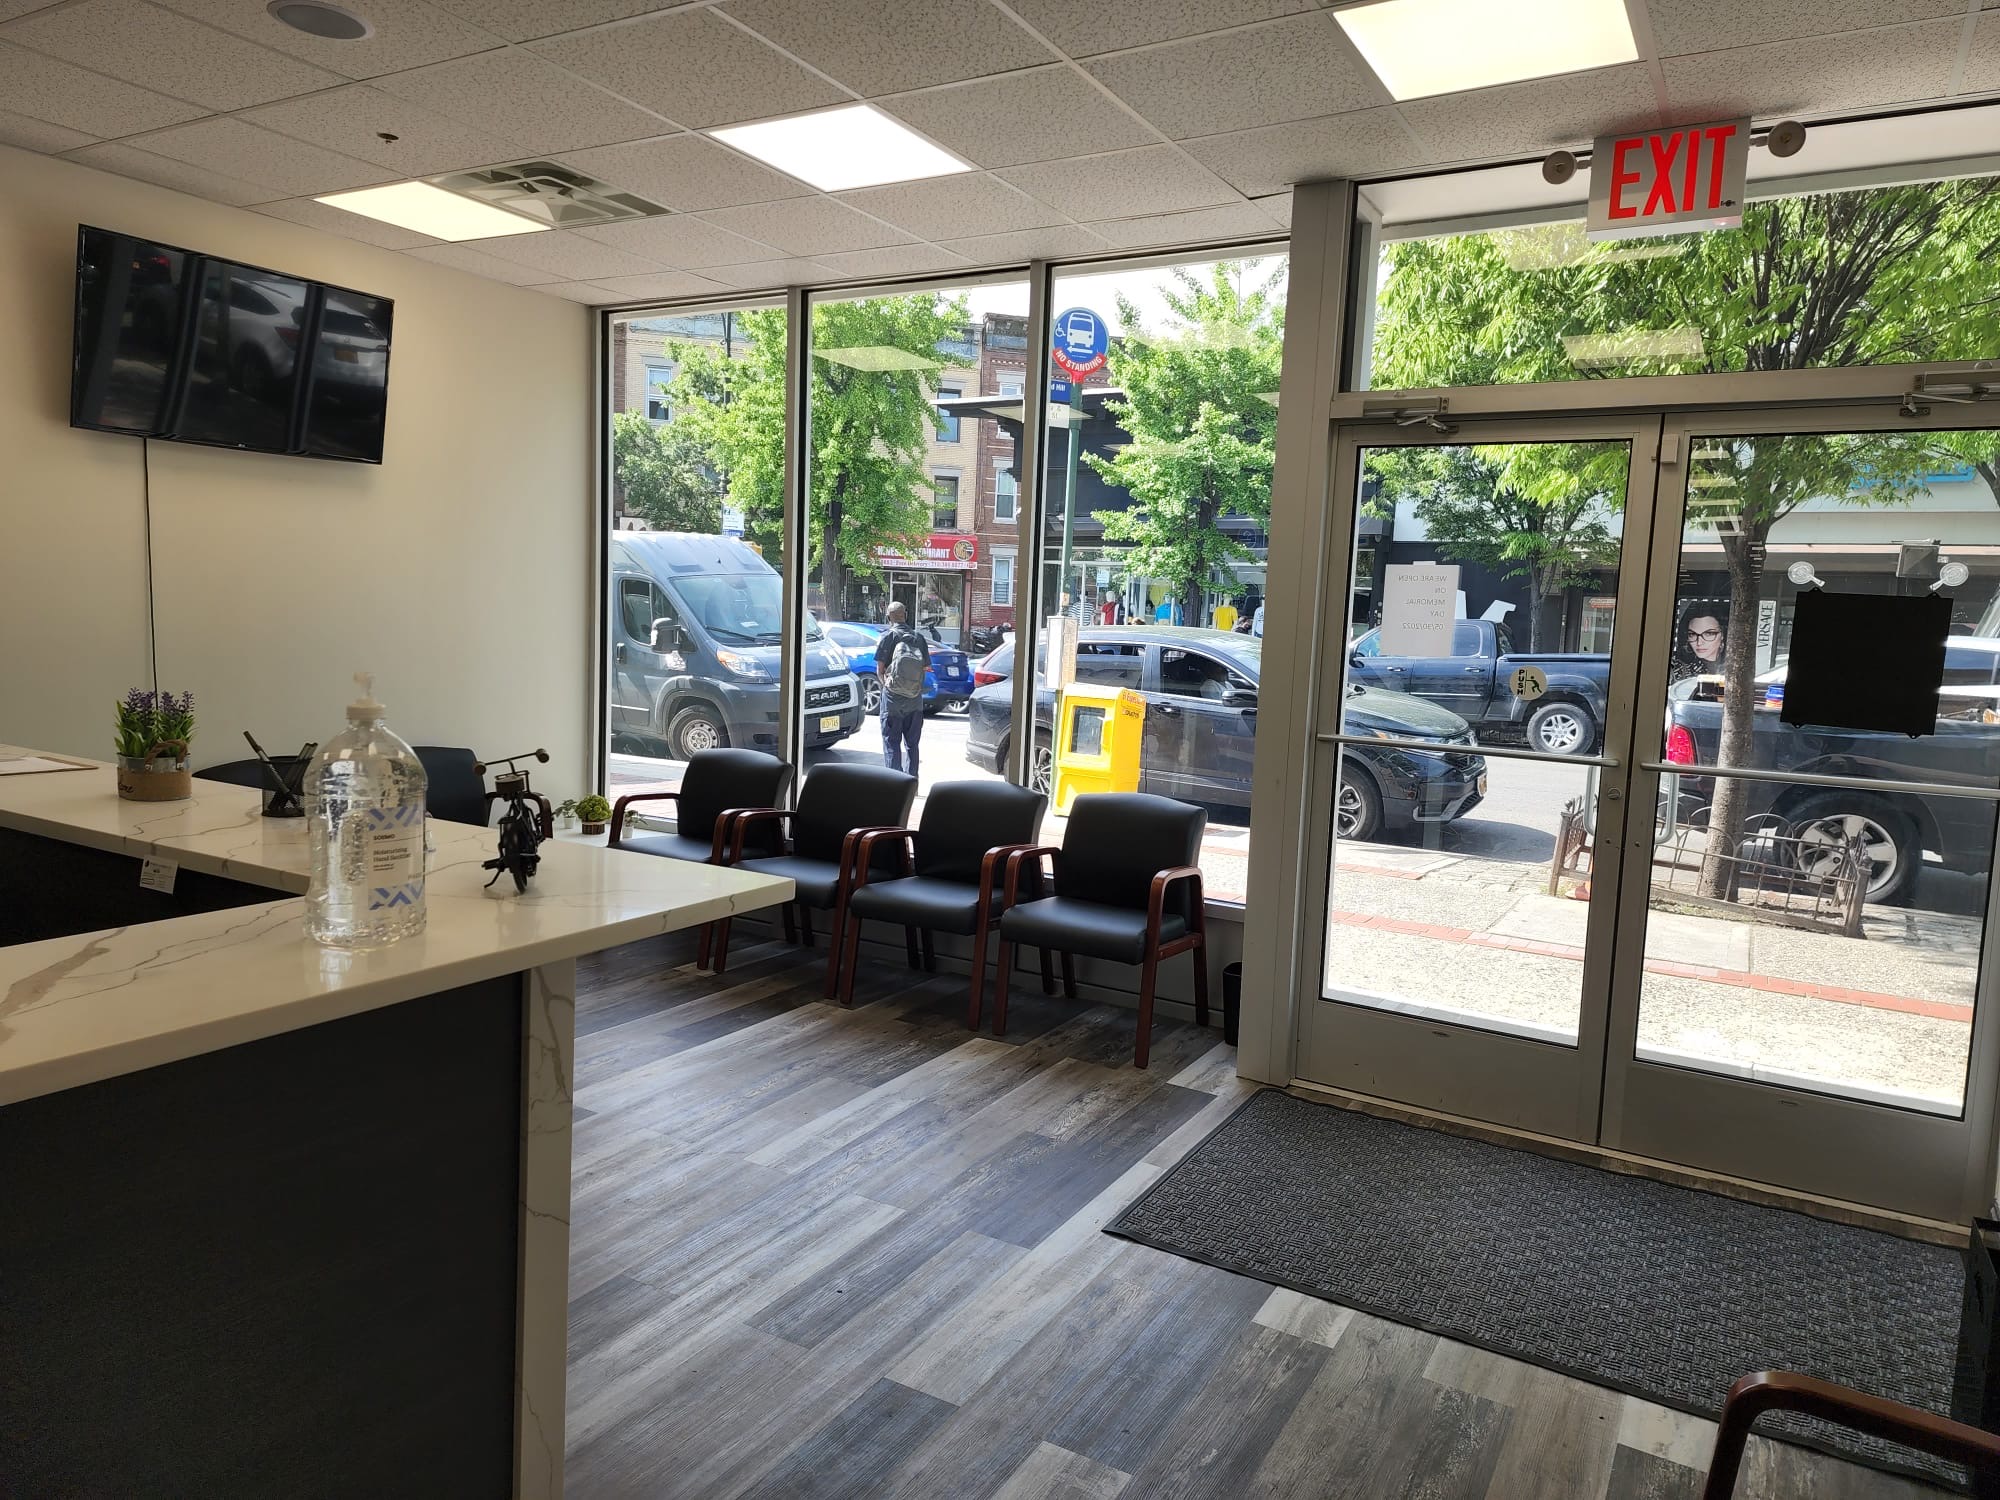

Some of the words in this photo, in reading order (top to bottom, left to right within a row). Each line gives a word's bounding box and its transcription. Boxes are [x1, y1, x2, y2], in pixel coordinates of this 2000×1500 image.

[1608, 125, 1736, 220] EXIT
[1055, 350, 1066, 362] NO
[1065, 356, 1103, 372] STANDING
[1757, 604, 1774, 648] VERSACE
[1517, 669, 1525, 695] PUSH
[810, 690, 840, 701] RAM
